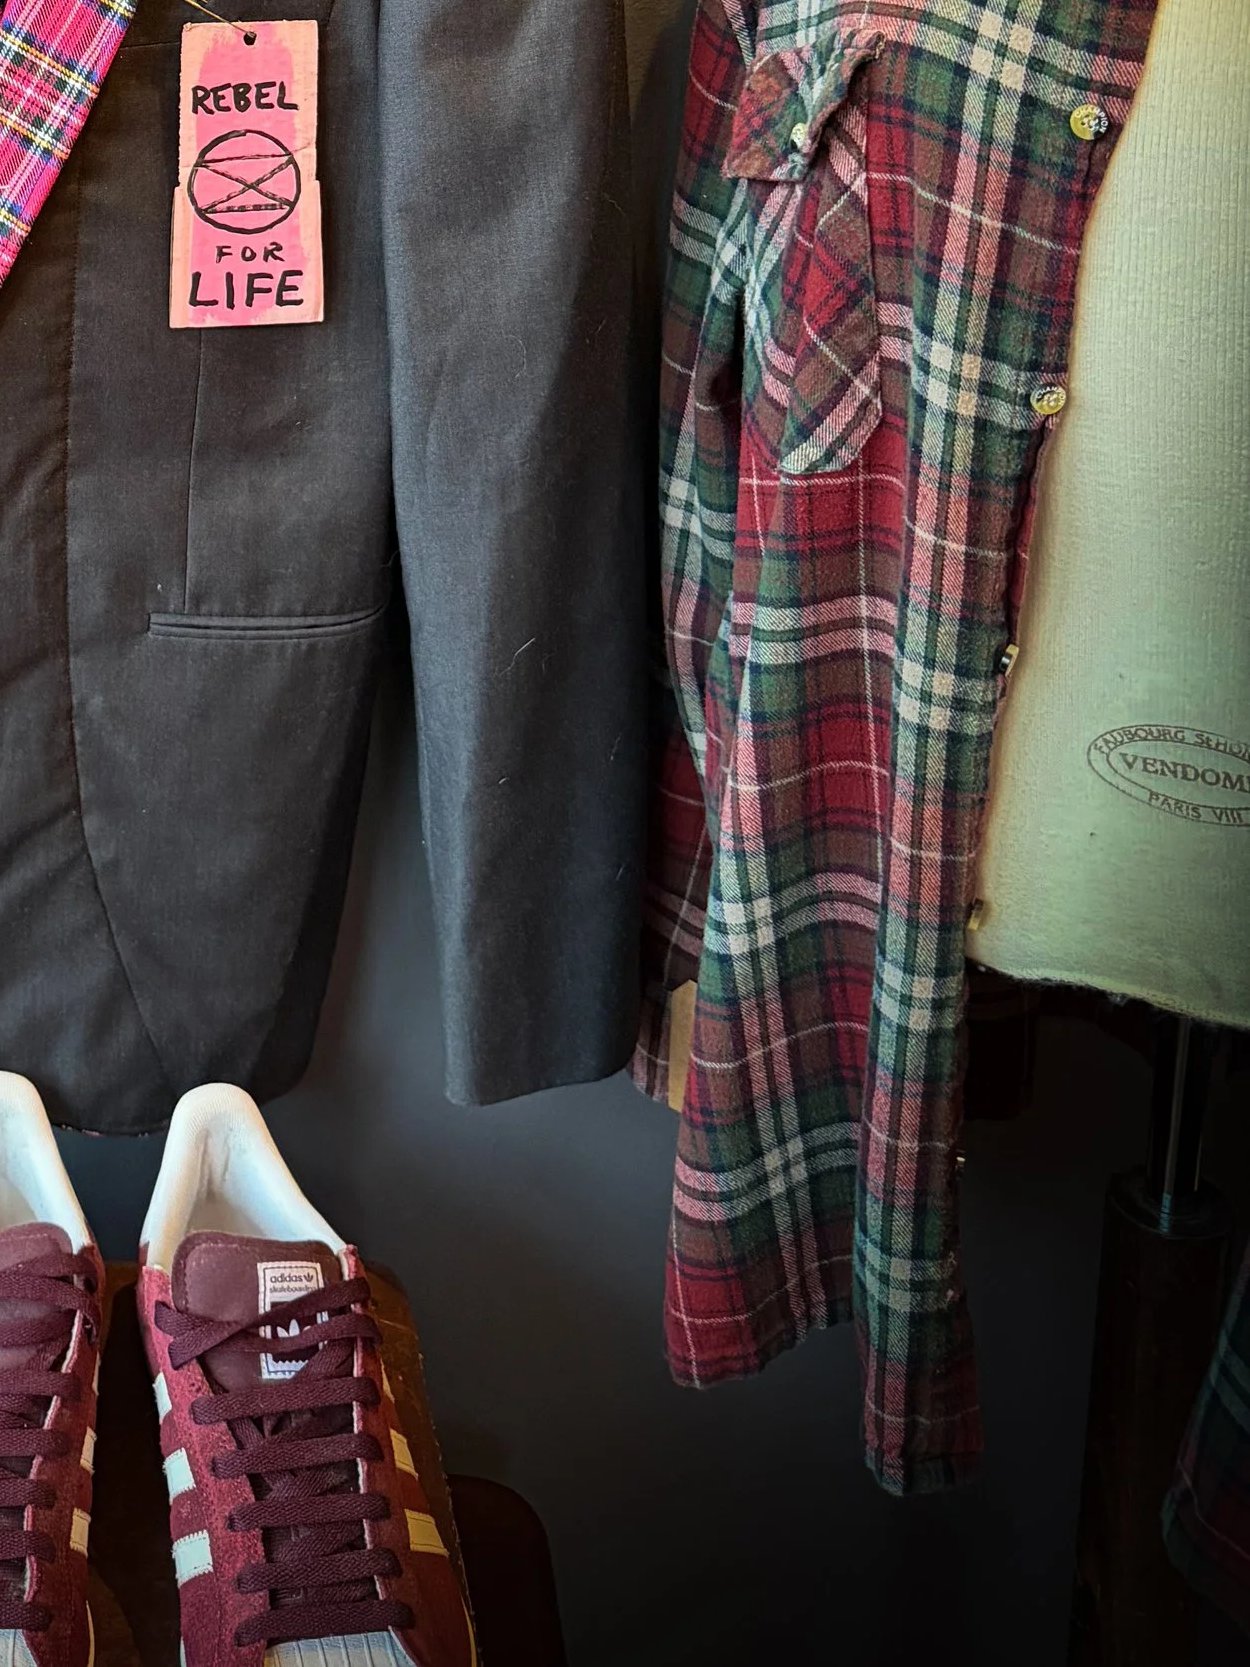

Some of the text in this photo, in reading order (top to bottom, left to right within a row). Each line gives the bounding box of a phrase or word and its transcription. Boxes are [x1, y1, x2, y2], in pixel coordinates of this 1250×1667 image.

[191, 81, 299, 115] REBEL
[216, 241, 285, 264] FOR
[188, 269, 304, 311] LIFE
[1093, 727, 1186, 755] FAUBOURG
[1148, 790, 1202, 819] PARIS
[270, 1273, 303, 1283] adidas
